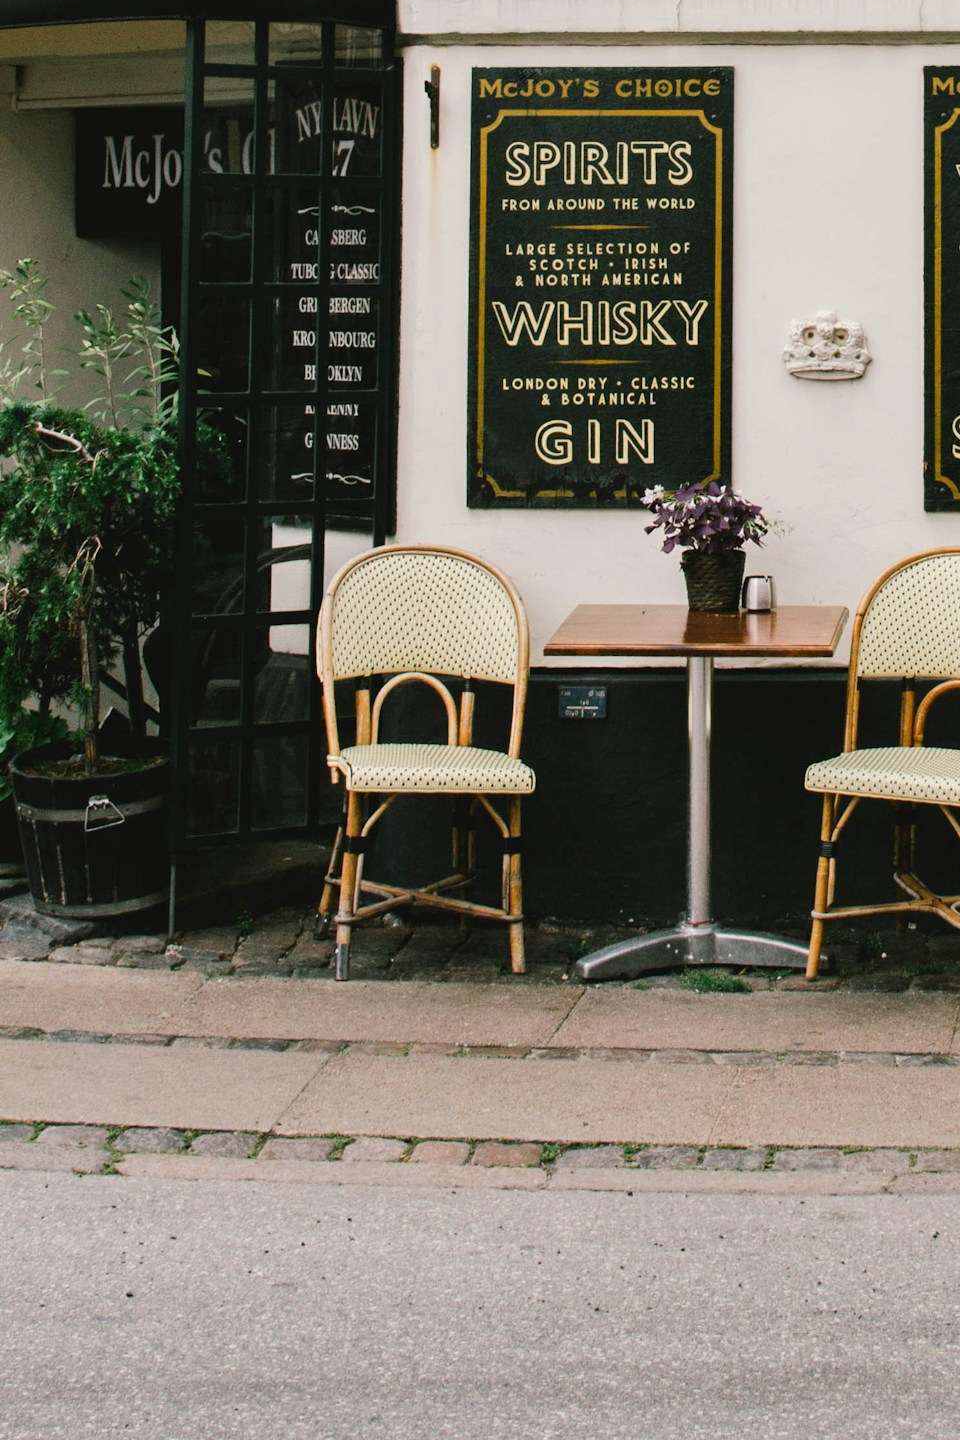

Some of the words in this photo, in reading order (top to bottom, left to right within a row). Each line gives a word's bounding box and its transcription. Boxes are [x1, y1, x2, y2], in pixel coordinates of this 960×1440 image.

[616, 79, 719, 97] CHOICE
[102, 132, 223, 205] McJo's
[506, 141, 692, 186] SPIRITS
[502, 199, 539, 210] FROM
[548, 199, 605, 210] AROUND
[613, 198, 638, 209] THE
[647, 198, 695, 209] WORLD
[306, 230, 366, 245] CASBERG
[506, 243, 556, 255] LARGE
[567, 243, 658, 255] SELECTION
[670, 242, 690, 254] OF
[291, 264, 335, 280] TUBOG
[337, 263, 379, 280] CLASSIC
[530, 259, 598, 271] SCOTCH
[626, 258, 667, 269] IRISH
[515, 276, 523, 286] &
[536, 274, 590, 286] NORTH
[602, 273, 681, 285] AMERICAN
[299, 297, 370, 313] GRIBERGEN
[492, 300, 708, 346] WHISKY
[293, 331, 375, 347] KRONBOURG
[305, 365, 362, 381] BOKLYN
[503, 378, 568, 390] LONDON
[578, 378, 607, 389] DRY
[631, 377, 694, 389] CLASSIC
[542, 394, 550, 405] &
[562, 393, 656, 405] BOTANICAL
[305, 433, 358, 450] GNNESS
[535, 419, 654, 465] GIN
